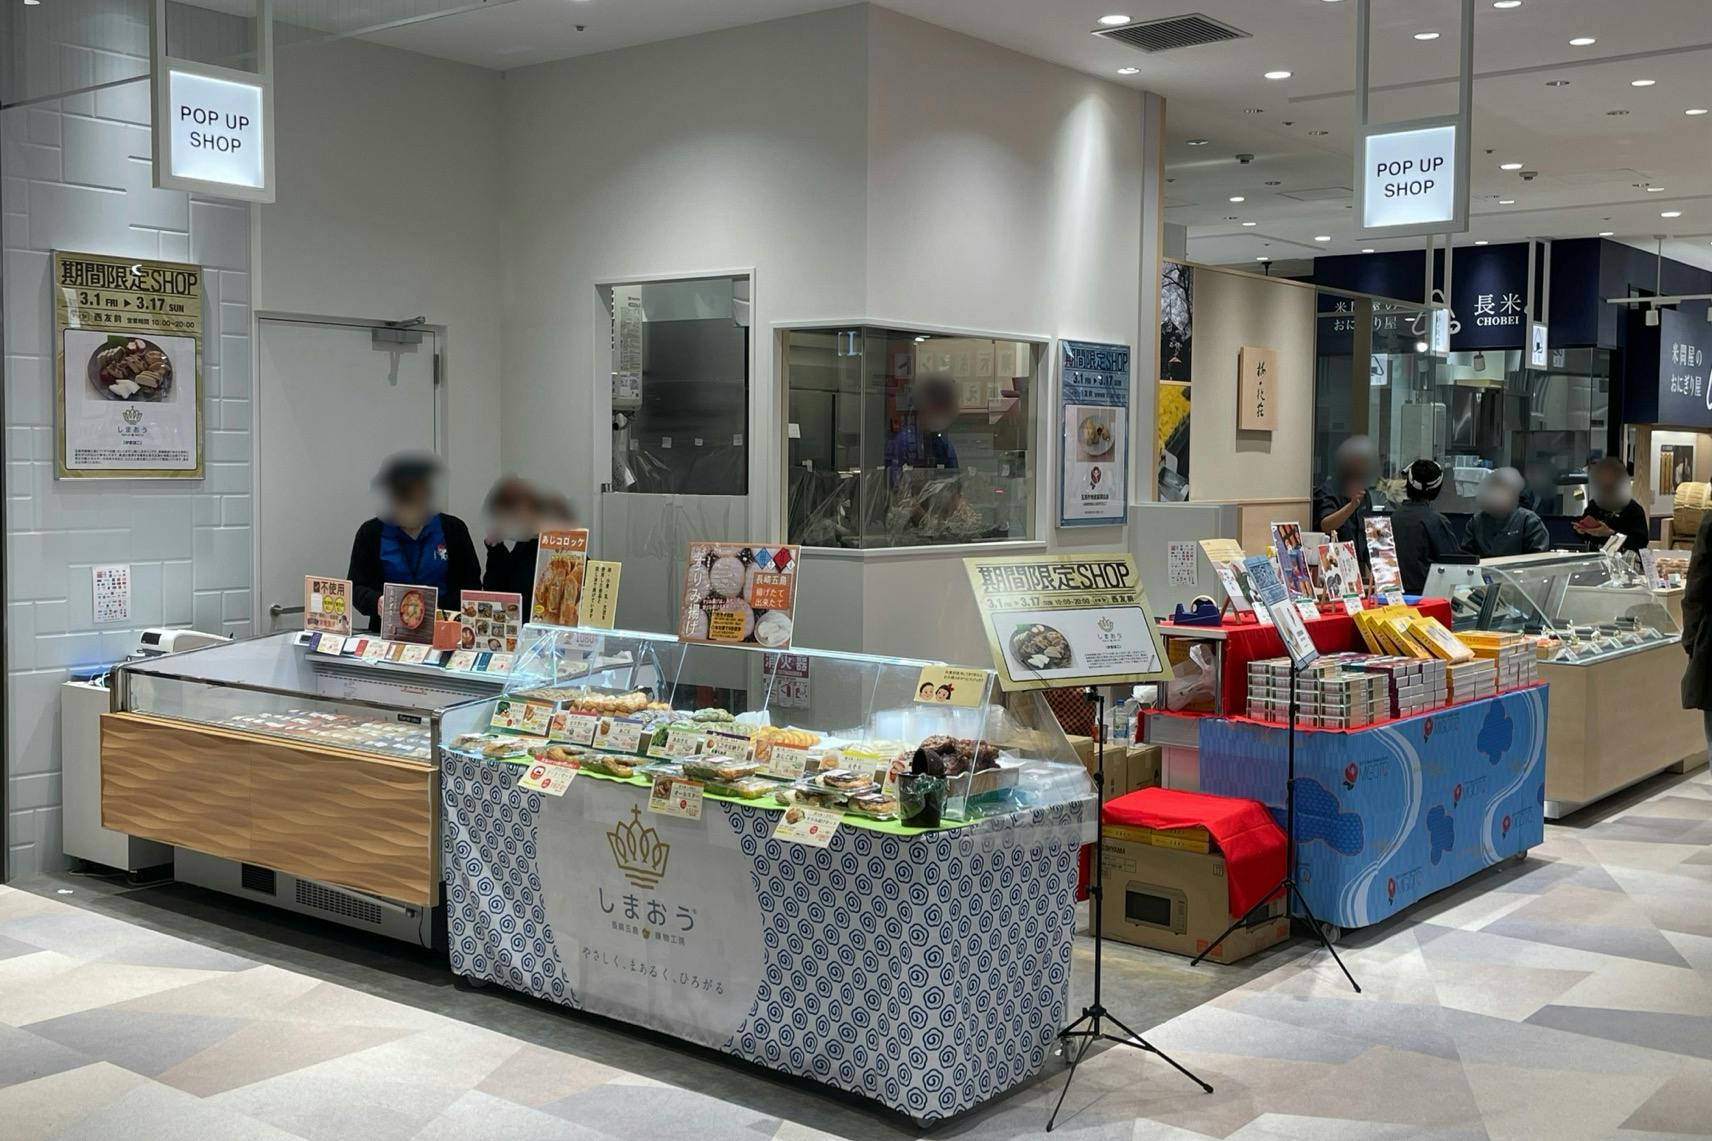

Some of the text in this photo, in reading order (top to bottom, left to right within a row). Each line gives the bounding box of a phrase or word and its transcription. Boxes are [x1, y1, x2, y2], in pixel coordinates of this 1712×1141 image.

[181, 106, 250, 131] POP UP
[190, 131, 242, 153] SHOP
[1377, 157, 1444, 177] POP UP
[1384, 180, 1435, 197] SHOP
[62, 260, 198, 295] 期間限定SHOP
[80, 292, 184, 313] 3.1 FRI 3.17 SUN
[1474, 293, 1521, 316] 長米
[1477, 315, 1519, 326] CHOBEI
[541, 535, 585, 547] あじコロッケ
[978, 562, 1130, 593] 期間限定SHOP
[987, 598, 1003, 609] 3.1
[1020, 596, 1040, 607] 3.17
